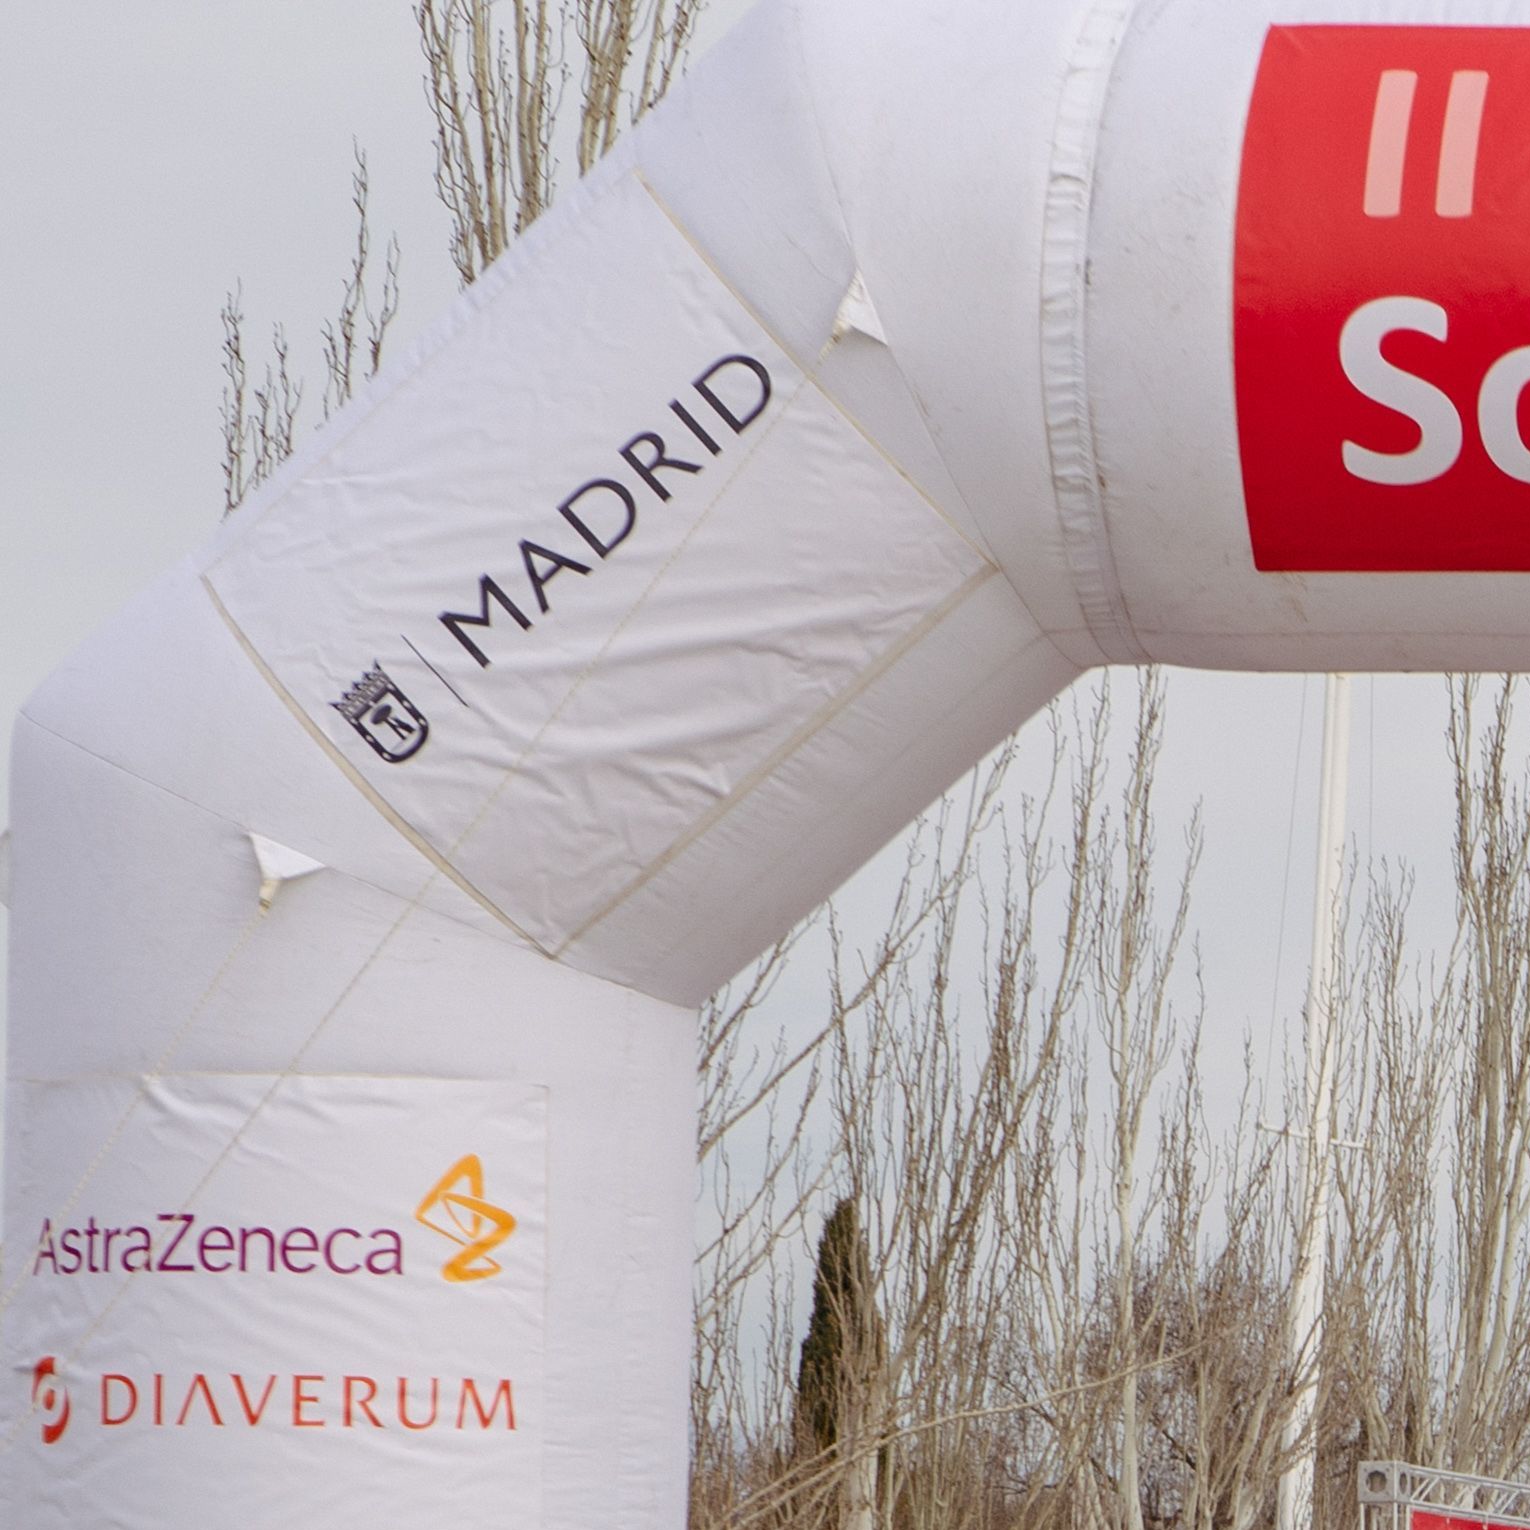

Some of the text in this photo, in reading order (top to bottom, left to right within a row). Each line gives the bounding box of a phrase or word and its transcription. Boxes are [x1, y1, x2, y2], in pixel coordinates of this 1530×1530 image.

[1363, 70, 1490, 219] II
[437, 353, 772, 669] MADRID
[32, 1213, 404, 1275] AstraZeneca
[101, 1372, 518, 1431] DIAVERUM
